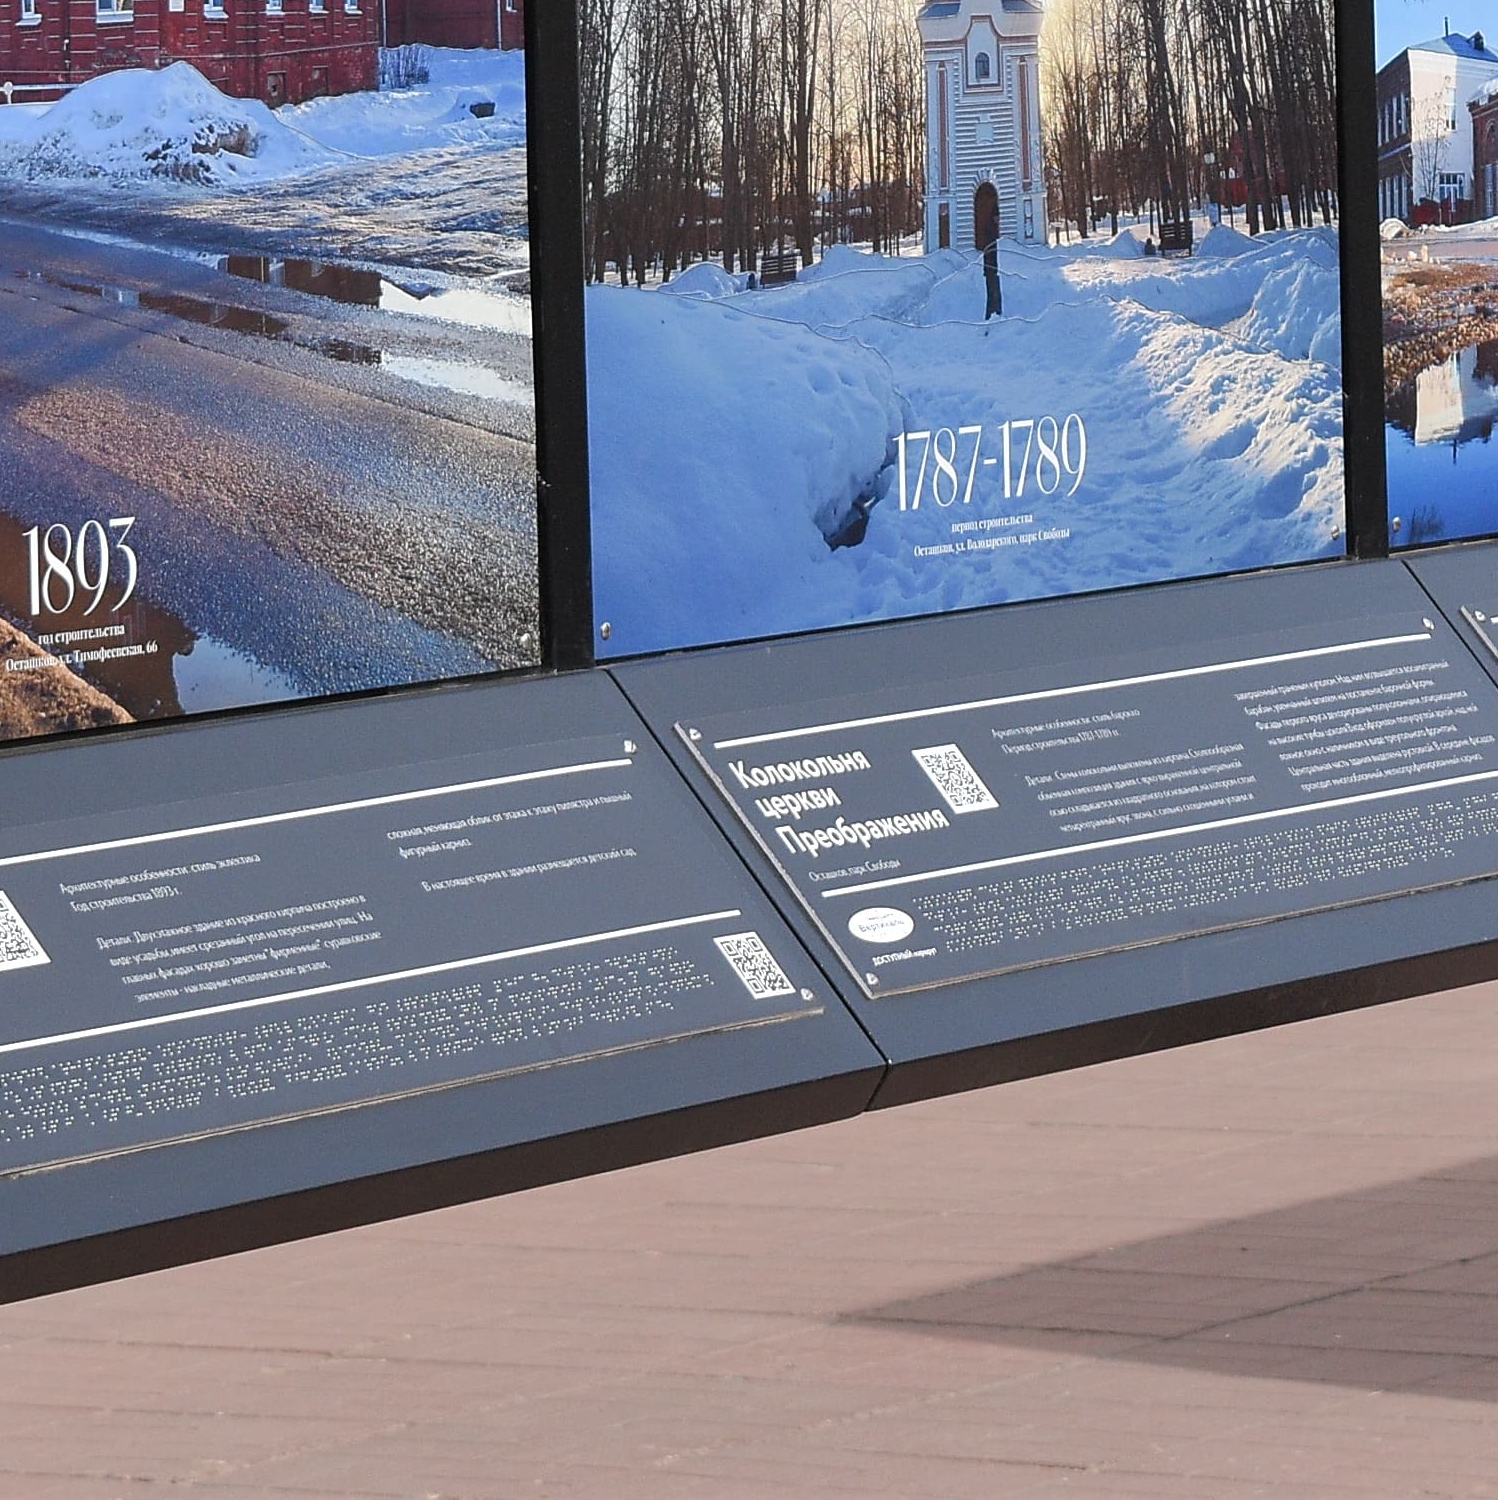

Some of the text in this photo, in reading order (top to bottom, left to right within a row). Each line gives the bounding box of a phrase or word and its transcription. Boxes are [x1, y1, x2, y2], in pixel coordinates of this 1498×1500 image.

[893, 413, 1088, 512] 1787-1789
[978, 513, 1034, 531] строительства
[21, 516, 138, 616] 1893
[37, 624, 126, 646] год строительства
[74, 644, 145, 664] Тимофеевская,
[146, 639, 158, 653] 66
[728, 750, 871, 789] Колокольня
[492, 812, 503, 822] от
[754, 786, 842, 820] церкви
[775, 808, 950, 858] Преображения
[60, 875, 129, 895] Архитектурные
[190, 861, 217, 873] стиль
[216, 853, 261, 868] эклектика
[431, 875, 475, 890] настоящее
[69, 900, 91, 912] Год
[89, 891, 153, 910] строительства
[150, 884, 175, 898] 1893
[192, 919, 224, 932] здание
[224, 916, 237, 927] из
[265, 929, 279, 939] на
[356, 910, 374, 922] На
